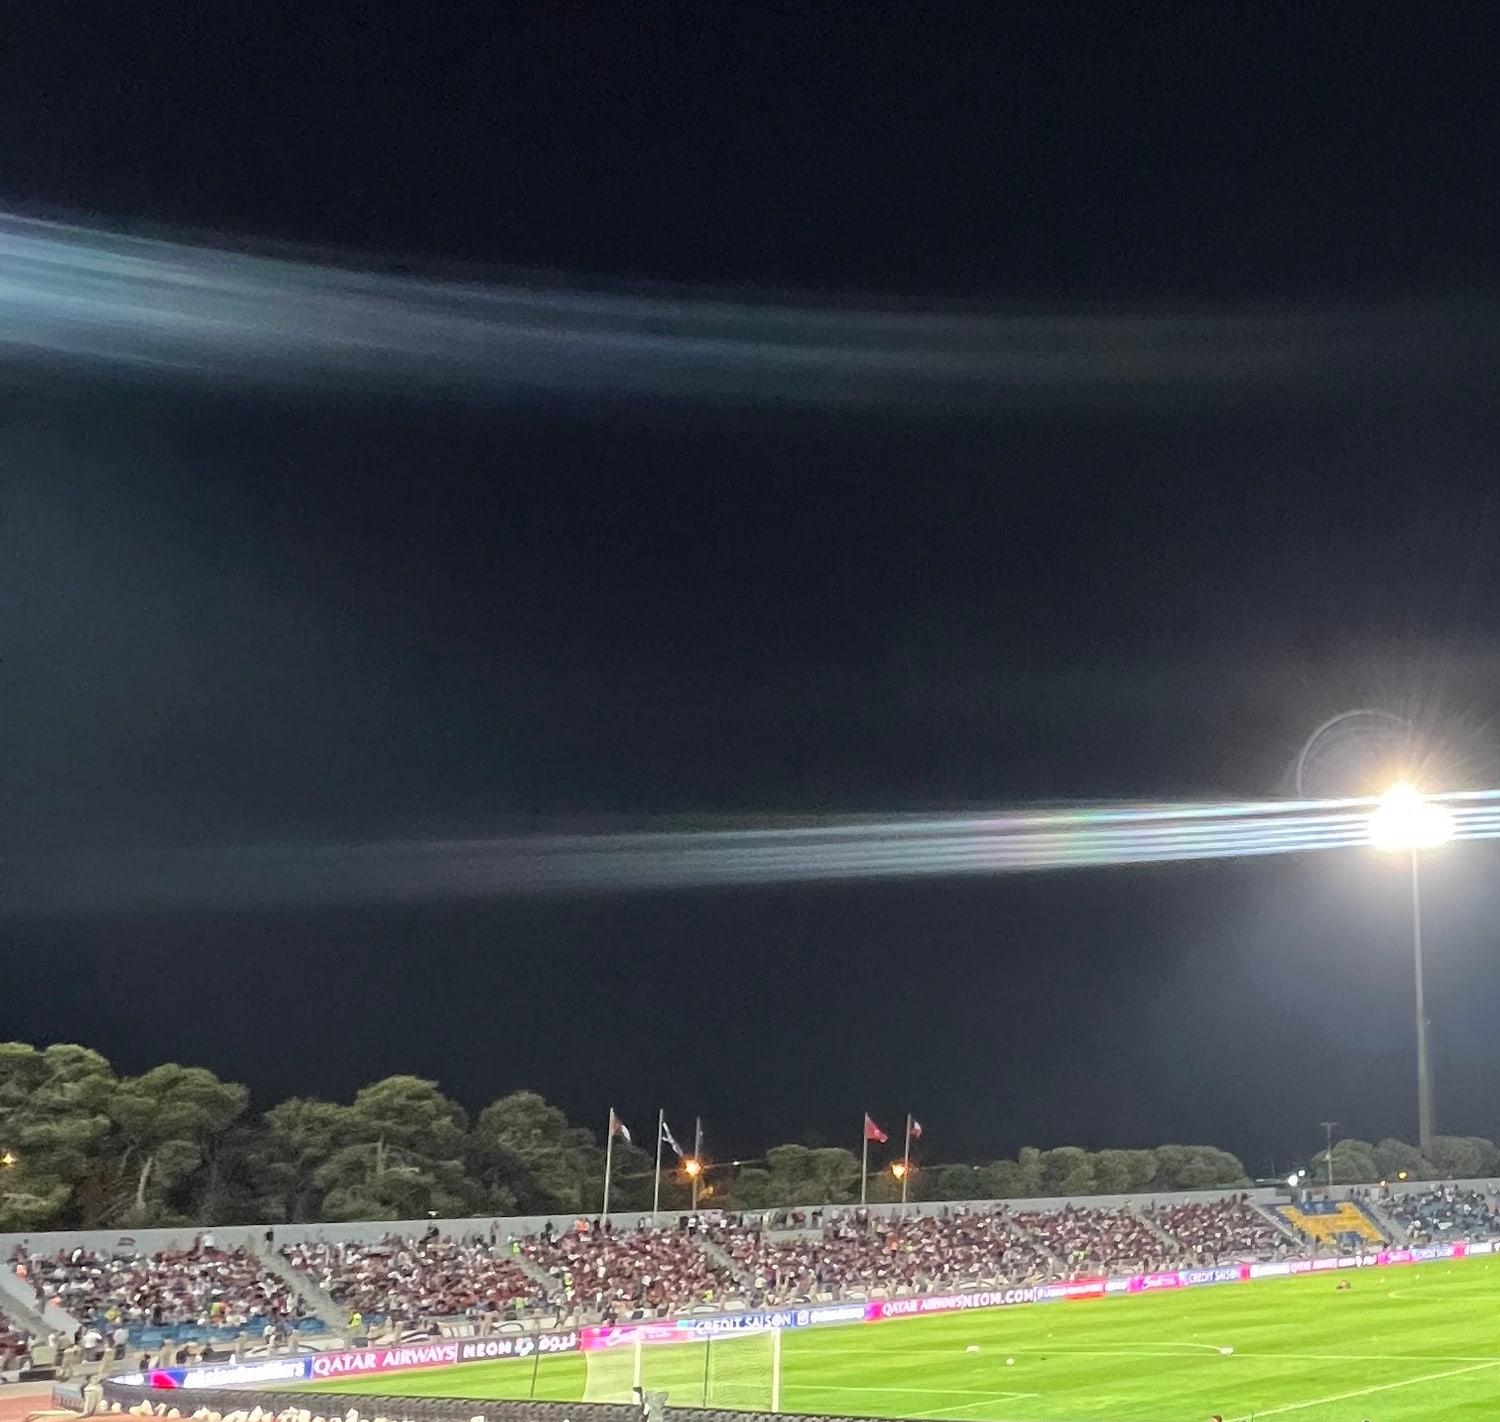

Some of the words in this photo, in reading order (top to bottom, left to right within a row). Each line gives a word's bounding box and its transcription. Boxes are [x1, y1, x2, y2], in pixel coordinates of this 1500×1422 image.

[964, 1289, 1035, 1308] NEOM.COM
[882, 1302, 918, 1316] QATAR
[463, 1341, 512, 1359] NEOM
[314, 1354, 377, 1376] QATAR
[382, 1345, 456, 1368] AIRWAYS
